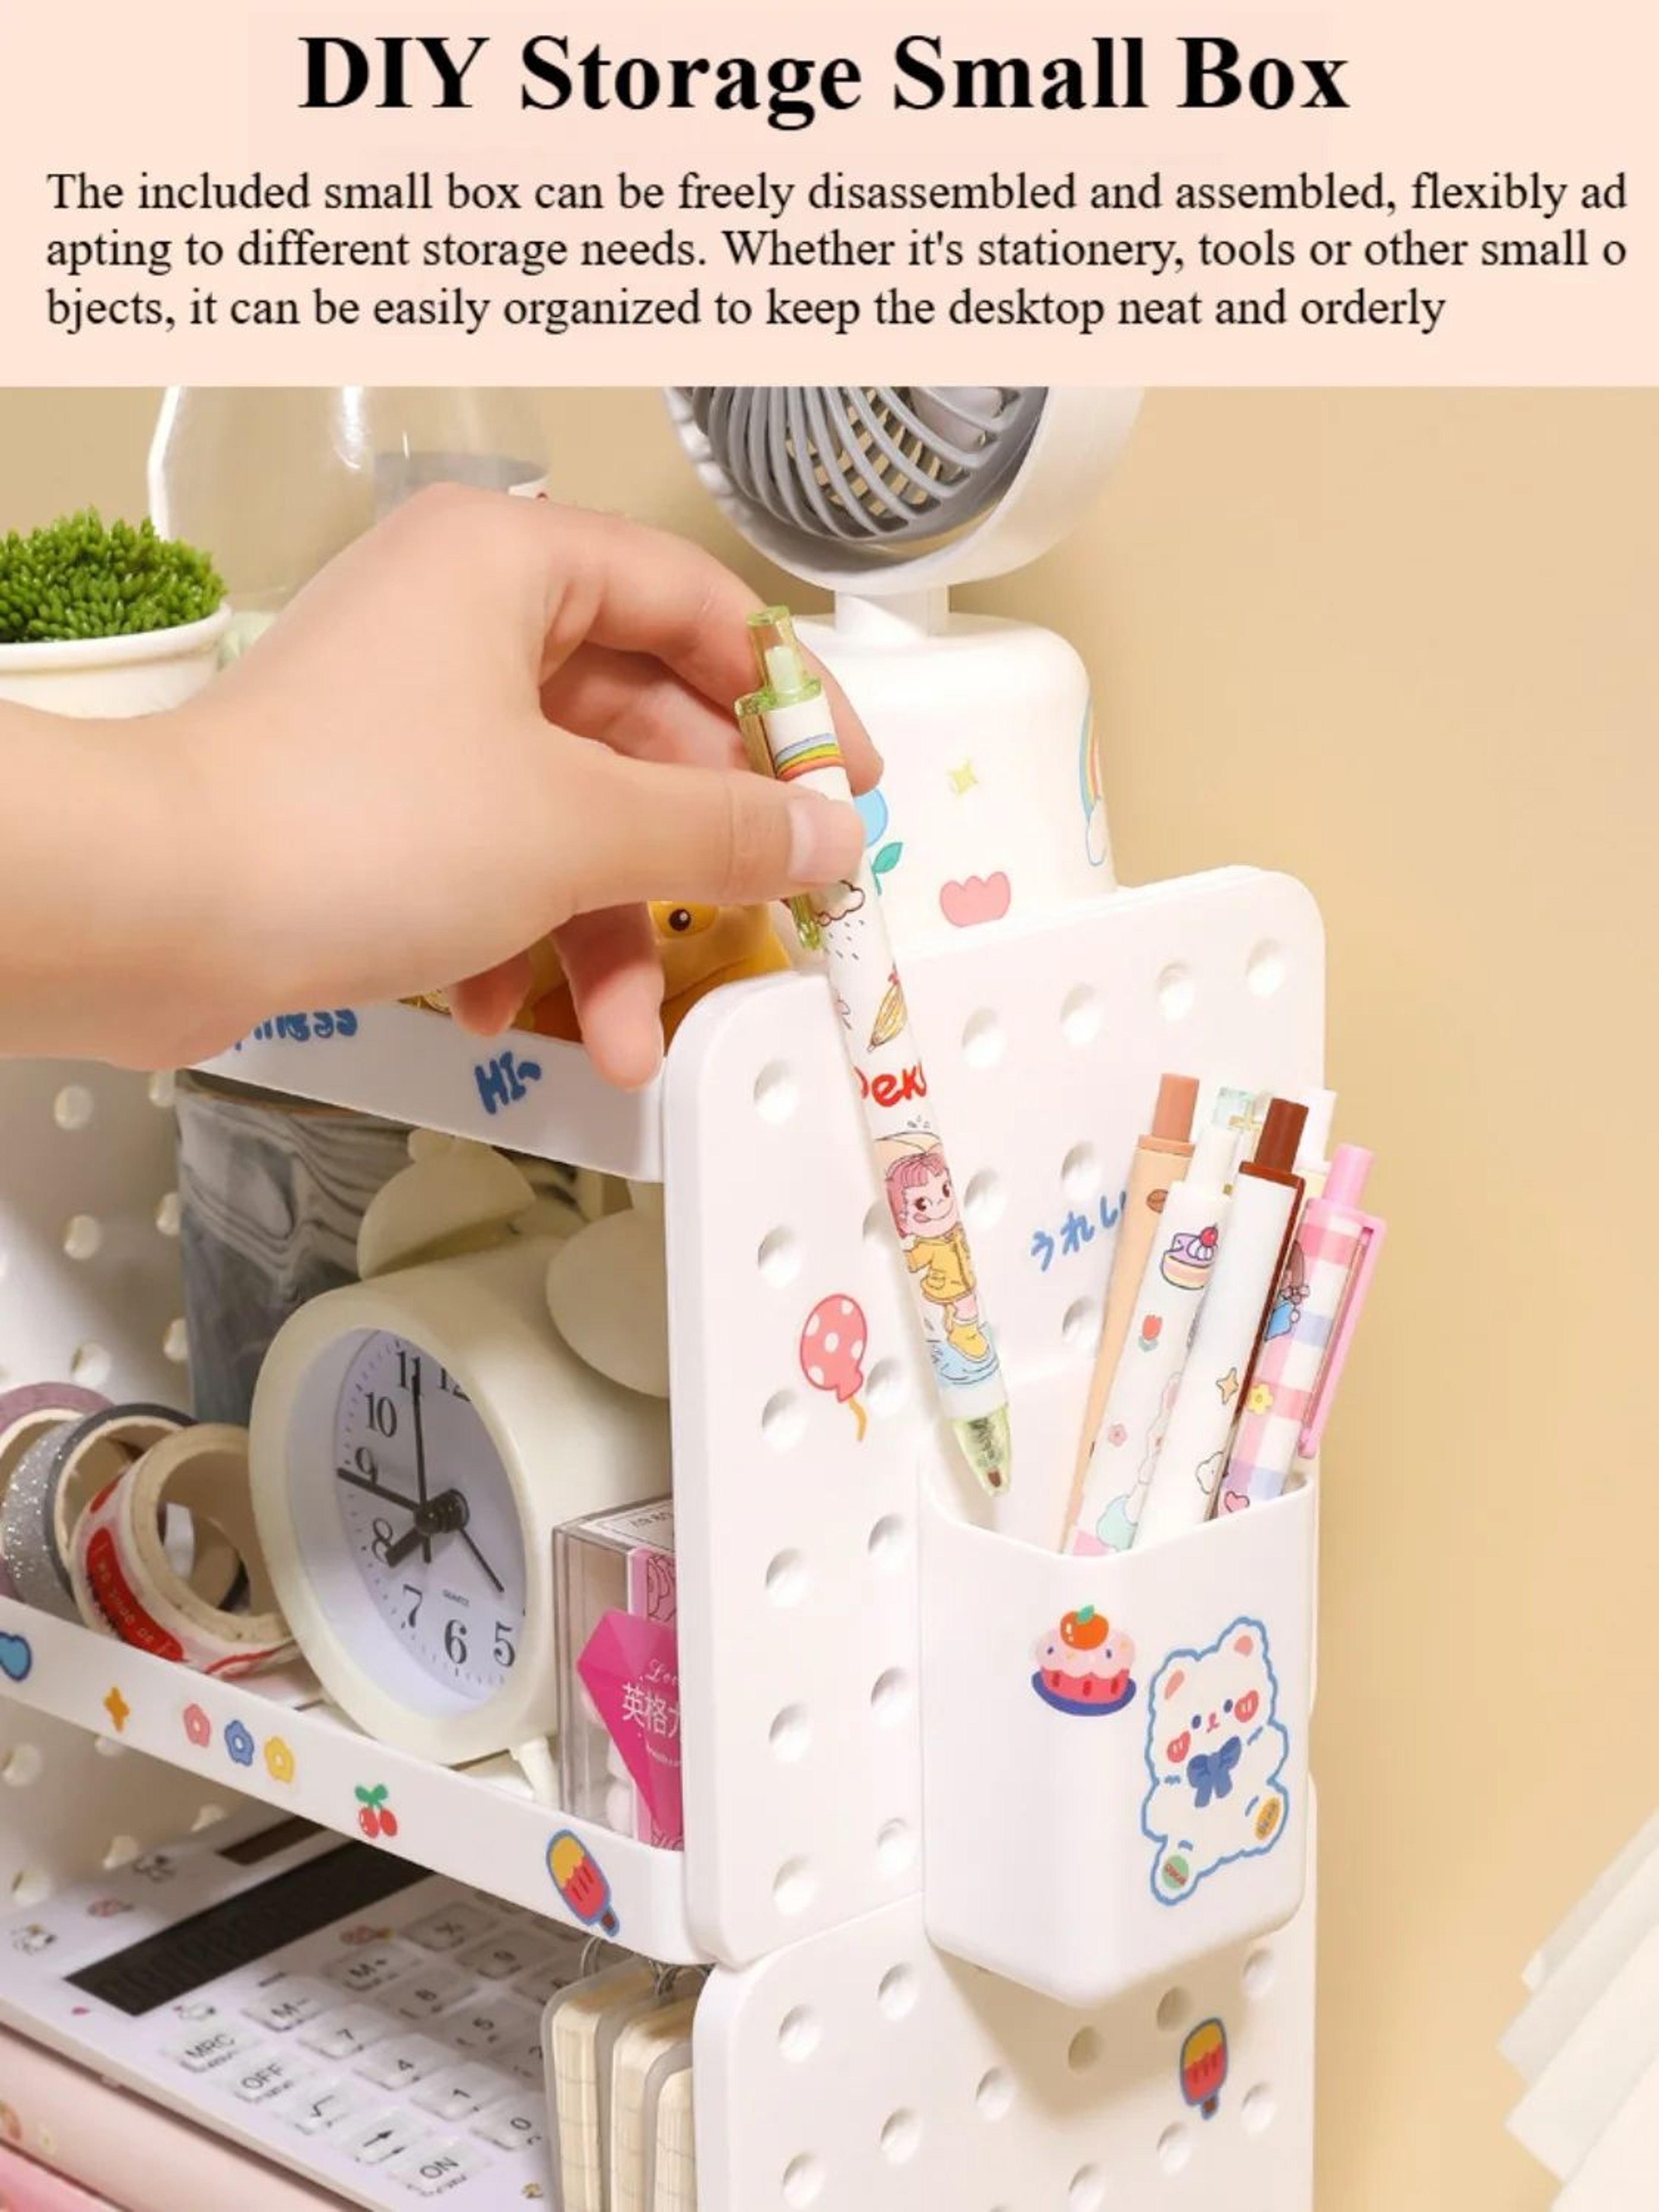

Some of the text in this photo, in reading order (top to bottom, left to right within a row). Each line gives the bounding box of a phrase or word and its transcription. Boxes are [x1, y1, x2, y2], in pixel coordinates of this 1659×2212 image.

[1031, 1191, 1127, 1271] うれし
[396, 1350, 422, 1400] 11
[365, 1392, 397, 1437] 10
[355, 1446, 378, 1485] 9
[372, 1518, 393, 1563] 8
[403, 1583, 423, 1628] 7
[444, 1619, 467, 1664] 6
[493, 1621, 515, 1667] 5
[185, 2033, 236, 2058] MRC
[397, 2058, 415, 2071] 4
[242, 2063, 284, 2090] OFF
[419, 2157, 460, 2179] ON
